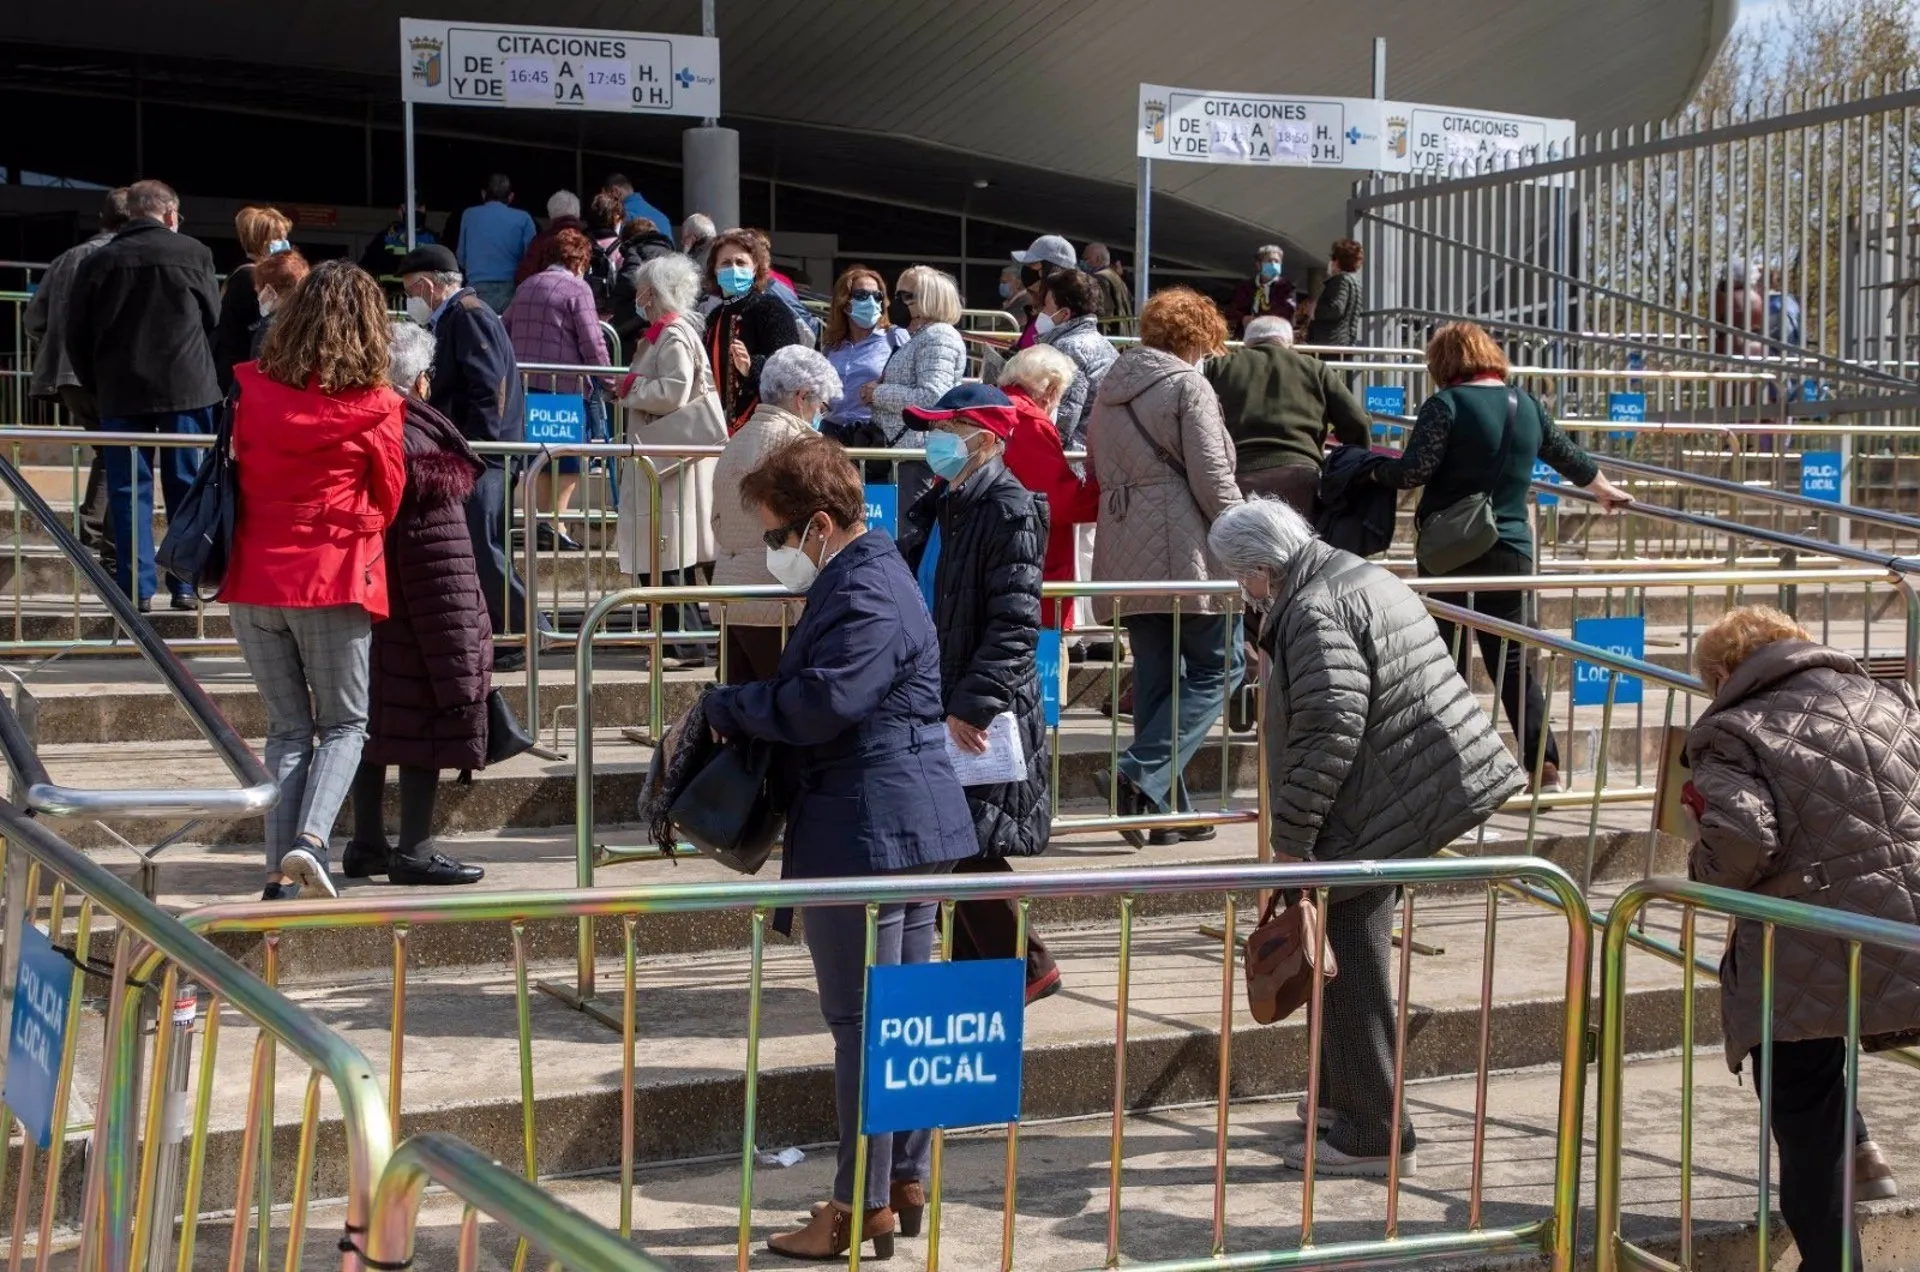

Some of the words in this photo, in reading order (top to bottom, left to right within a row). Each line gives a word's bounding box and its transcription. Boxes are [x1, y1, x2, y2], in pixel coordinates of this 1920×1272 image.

[497, 35, 626, 59] CITACIONES
[464, 56, 493, 74] DE
[511, 69, 549, 84] 16:45
[559, 61, 574, 78] A
[588, 72, 626, 86] 17:45
[640, 65, 658, 83] H.
[453, 77, 468, 95] Y
[474, 79, 503, 97] DE
[570, 83, 584, 100] A
[1205, 100, 1307, 121] CITACIONES
[1180, 117, 1201, 134] DE
[1251, 123, 1264, 138] A
[1442, 116, 1519, 139] CITACIONES
[1172, 136, 1182, 152] Y
[1187, 137, 1208, 154] DE
[1259, 142, 1271, 157] A
[1420, 132, 1440, 149] DE
[1479, 139, 1488, 153] A
[1414, 150, 1423, 165] Y
[530, 408, 579, 425] POLICIA
[532, 424, 576, 440] LOCAL
[1578, 665, 1630, 684] LOCL
[19, 962, 63, 1036] POLICIA
[879, 1010, 1006, 1047] POLICIA
[15, 1008, 51, 1077] LOCAL
[885, 1052, 998, 1090] LOCAL
